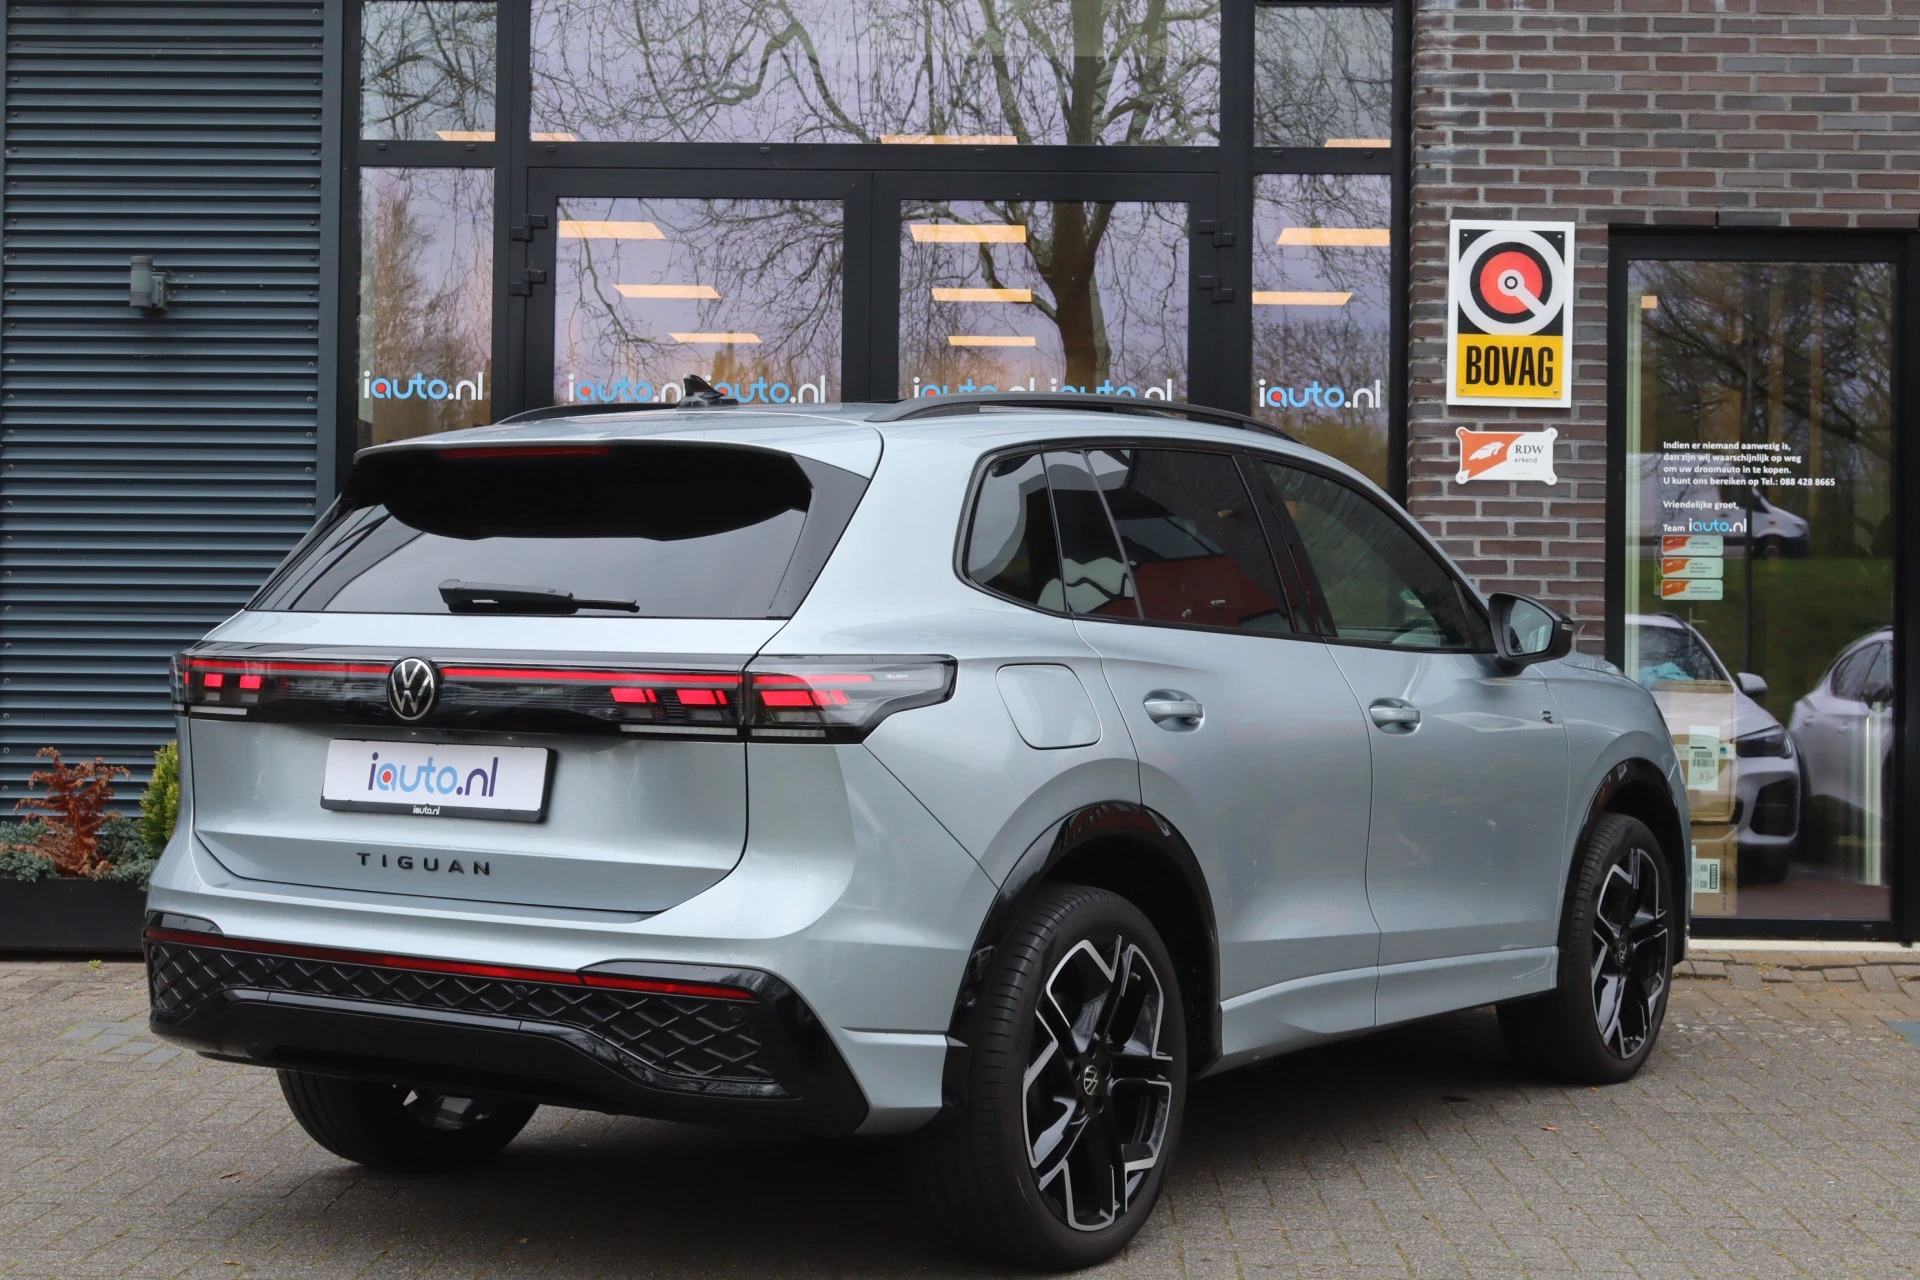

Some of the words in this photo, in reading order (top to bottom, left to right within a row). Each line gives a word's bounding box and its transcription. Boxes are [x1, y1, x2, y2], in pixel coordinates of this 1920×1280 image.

[1466, 345, 1554, 387] BOVAG
[363, 370, 484, 401] iauto.nl
[567, 373, 687, 403] iauto.n
[1258, 377, 1381, 408] iauto.nl
[1514, 444, 1544, 455] RDW
[1663, 441, 1690, 450] Indien
[1702, 442, 1739, 450] niemand
[1741, 442, 1780, 452] aanwezig
[1781, 442, 1792, 451] is,
[1514, 456, 1538, 464] erkend
[1663, 453, 1679, 461] dan
[1681, 453, 1696, 463] zijn
[1697, 454, 1711, 463] wij
[1712, 454, 1769, 463] waarschijnlijk
[1771, 455, 1782, 463] op
[1784, 455, 1802, 464] weg
[1694, 465, 1741, 474] droomauto
[1742, 465, 1751, 474] in
[1753, 466, 1761, 474] te
[1763, 465, 1792, 475] kopen.
[1663, 477, 1670, 485] U
[1672, 477, 1691, 485] kunt
[1710, 477, 1746, 485] bereiken
[1748, 478, 1759, 487] op
[1760, 478, 1779, 486] Tel.:
[1780, 478, 1796, 486] 088
[1797, 478, 1813, 486] 428
[1815, 478, 1836, 486] 8665
[1662, 500, 1712, 510] Vriendelijke
[1714, 501, 1740, 510] groet,
[1662, 524, 1685, 532] Team
[1688, 518, 1747, 532] iauto.nl
[367, 752, 499, 797] iauto.nl
[412, 805, 441, 816] iauto.nl
[356, 852, 491, 876] TIGUAN
